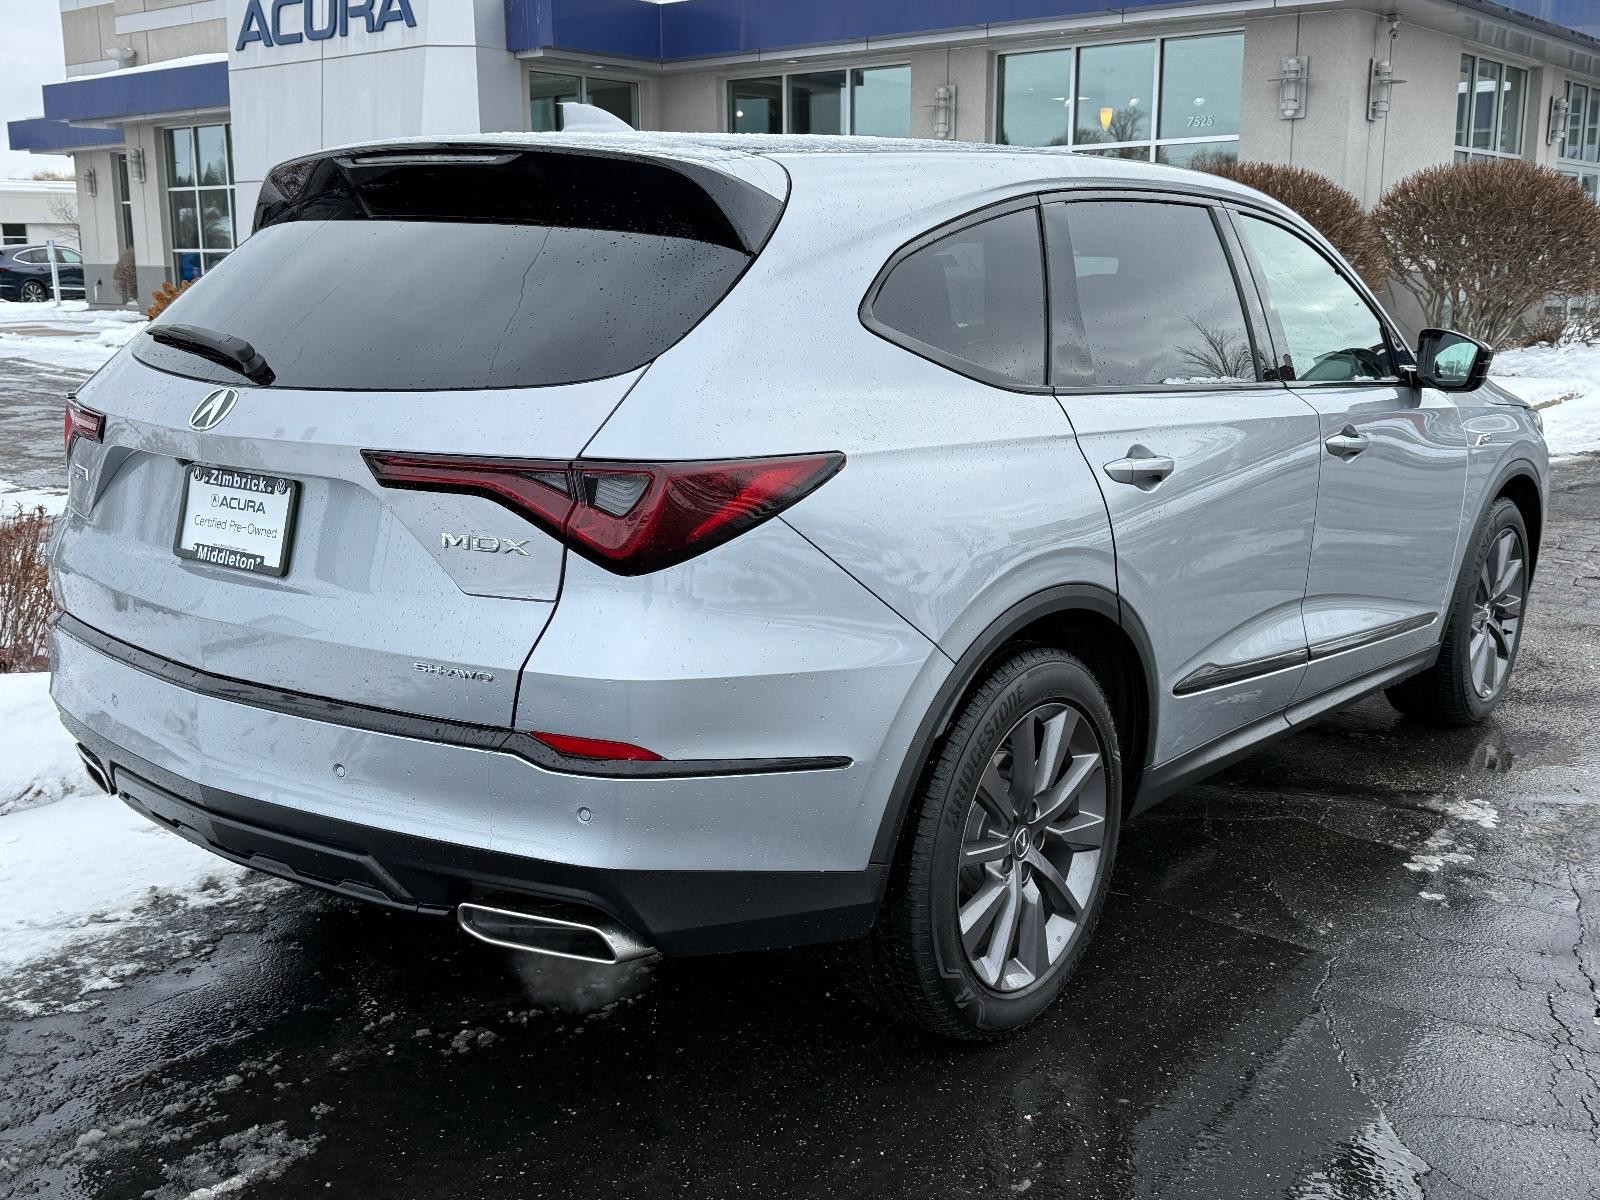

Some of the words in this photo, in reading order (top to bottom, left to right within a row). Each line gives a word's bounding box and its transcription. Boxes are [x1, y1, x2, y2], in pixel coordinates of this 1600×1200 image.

[235, 0, 417, 51] ACURA
[1187, 115, 1215, 128] 7525
[210, 469, 267, 492] Zimbrick
[219, 495, 266, 514] ACURA
[194, 514, 228, 530] Certified
[229, 520, 278, 539] Pre-Owned
[441, 531, 531, 556] MDX
[197, 545, 255, 570] Middleton
[944, 683, 1025, 832] BRIDGESTONE
